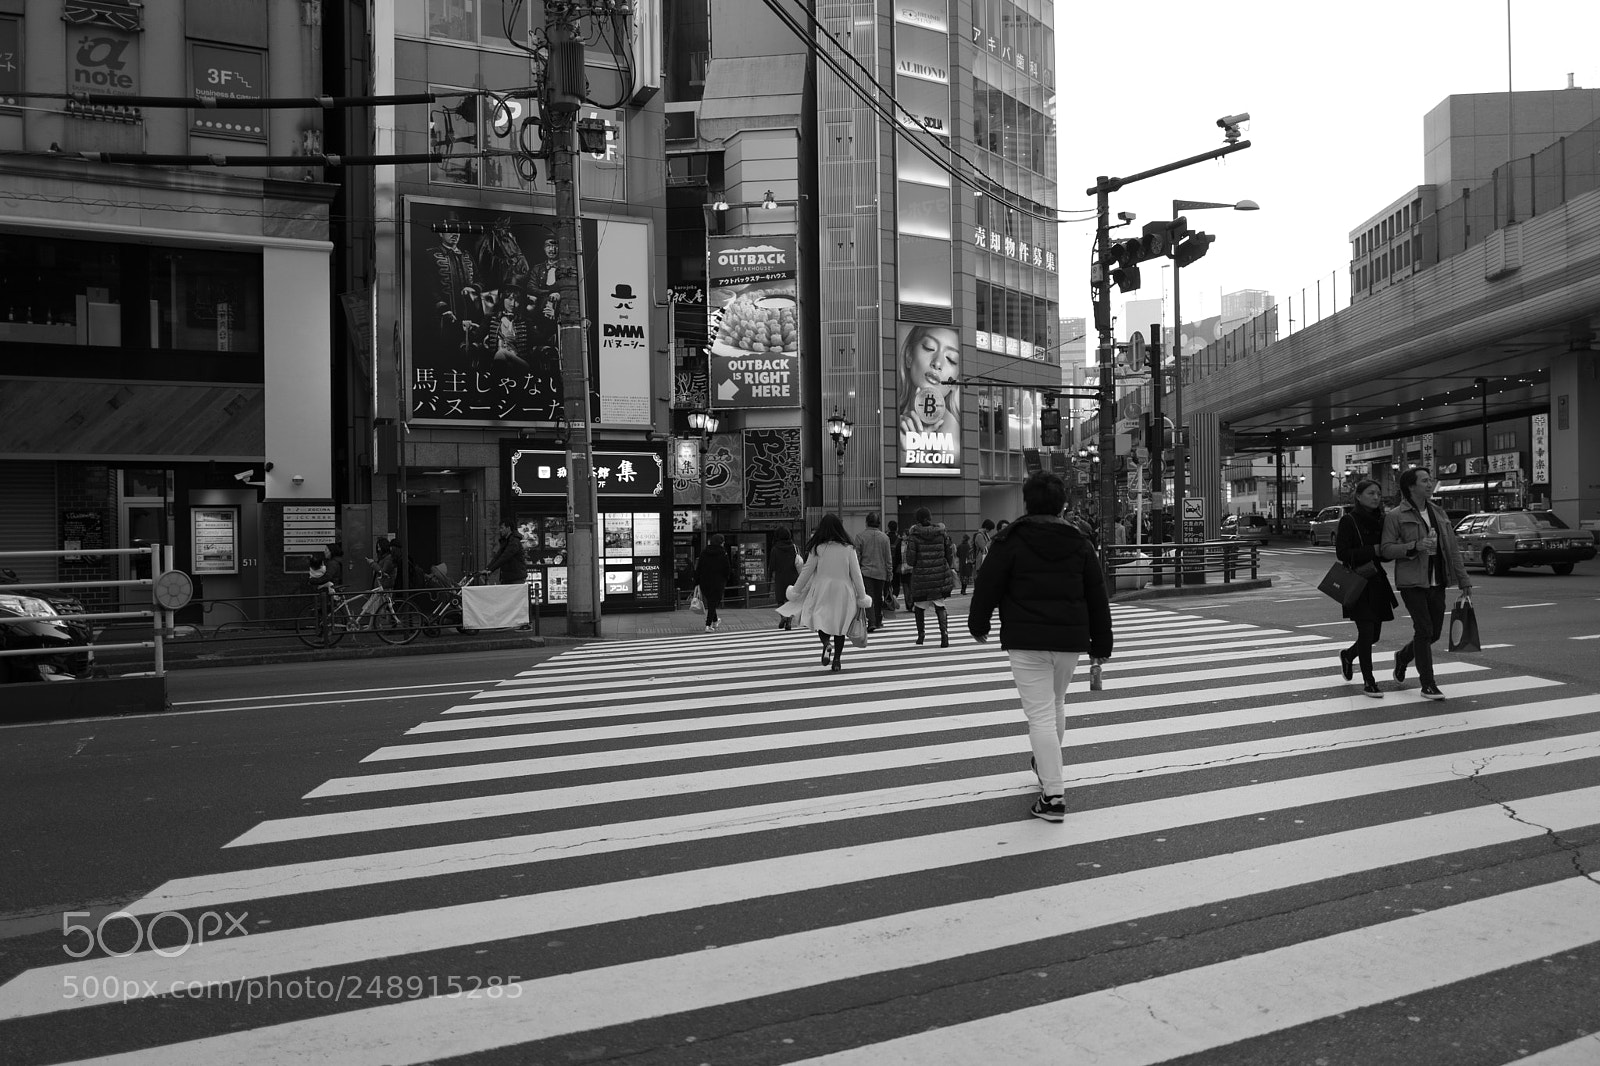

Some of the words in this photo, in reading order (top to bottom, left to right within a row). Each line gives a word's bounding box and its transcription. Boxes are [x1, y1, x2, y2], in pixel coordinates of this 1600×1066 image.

[208, 68, 232, 85] 3F
[899, 60, 946, 79] ALMOND
[75, 69, 133, 88] note
[974, 226, 1056, 271] 売却物件募集
[717, 253, 786, 265] OUTBACK
[718, 272, 787, 285] アウトバックステーキハウス
[603, 324, 645, 338] DMM
[603, 339, 645, 348] バヌーシー
[728, 359, 790, 371] OUTBACK
[733, 372, 742, 380] IS
[744, 371, 790, 384] RIGHT
[751, 385, 790, 398] HERE
[905, 431, 954, 451] DMM
[905, 450, 955, 464] Bitcoin
[616, 460, 638, 483] 集
[242, 558, 257, 567] 511
